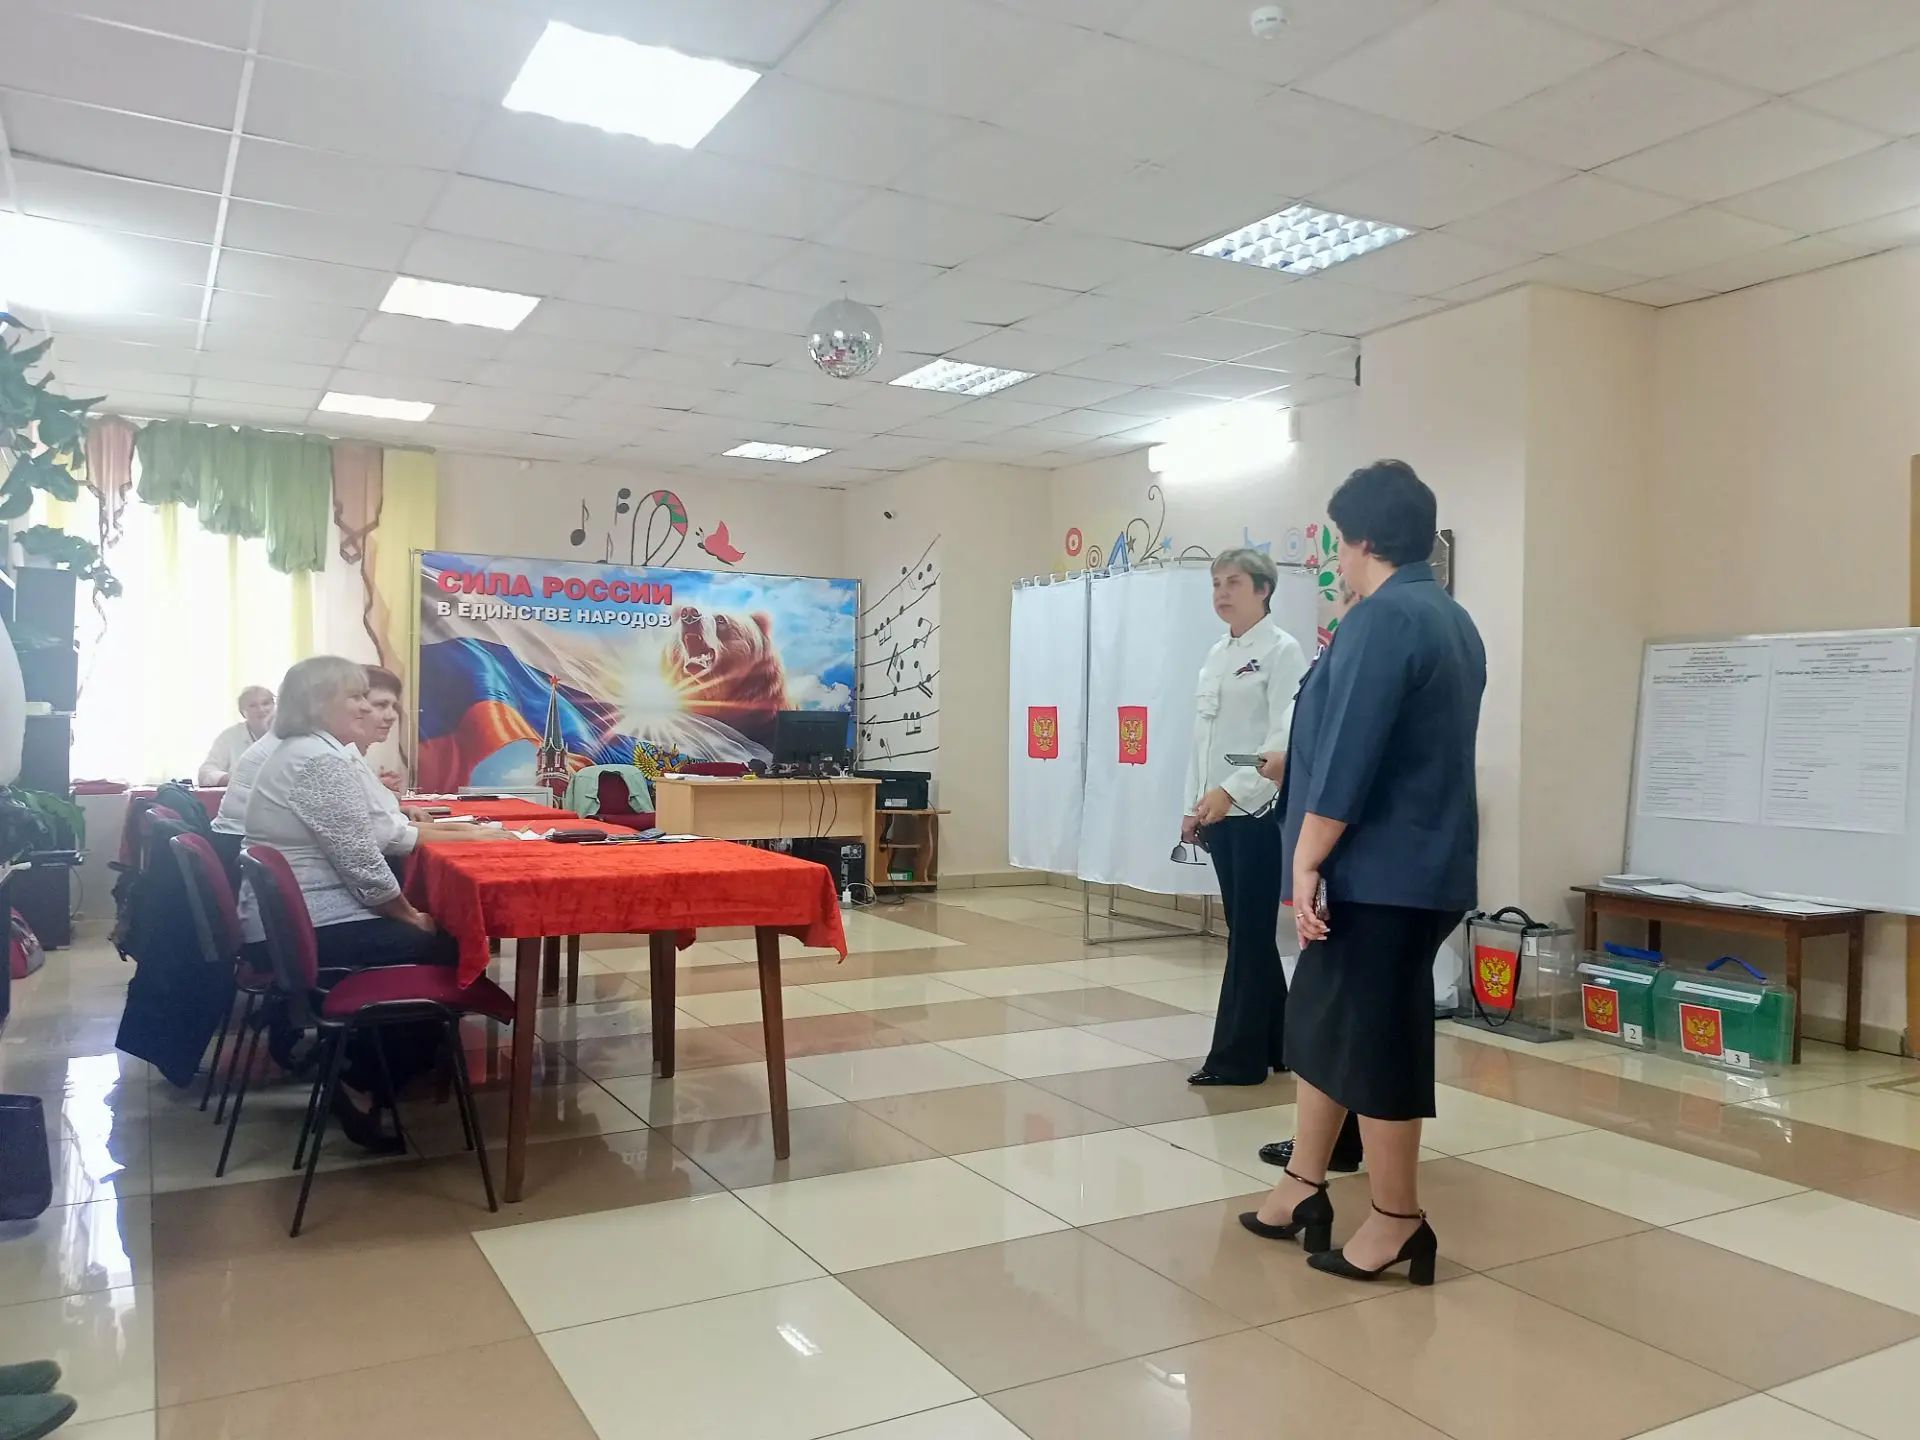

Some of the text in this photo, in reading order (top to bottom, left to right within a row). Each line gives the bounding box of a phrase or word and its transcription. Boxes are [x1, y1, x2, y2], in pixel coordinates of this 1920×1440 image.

[437, 570, 672, 605] СИЛА РОССИИ
[437, 601, 671, 628] В ЕДИНСТВЕ НАРОДОВ
[1629, 1028, 1636, 1039] 2
[1734, 1054, 1741, 1064] 3
